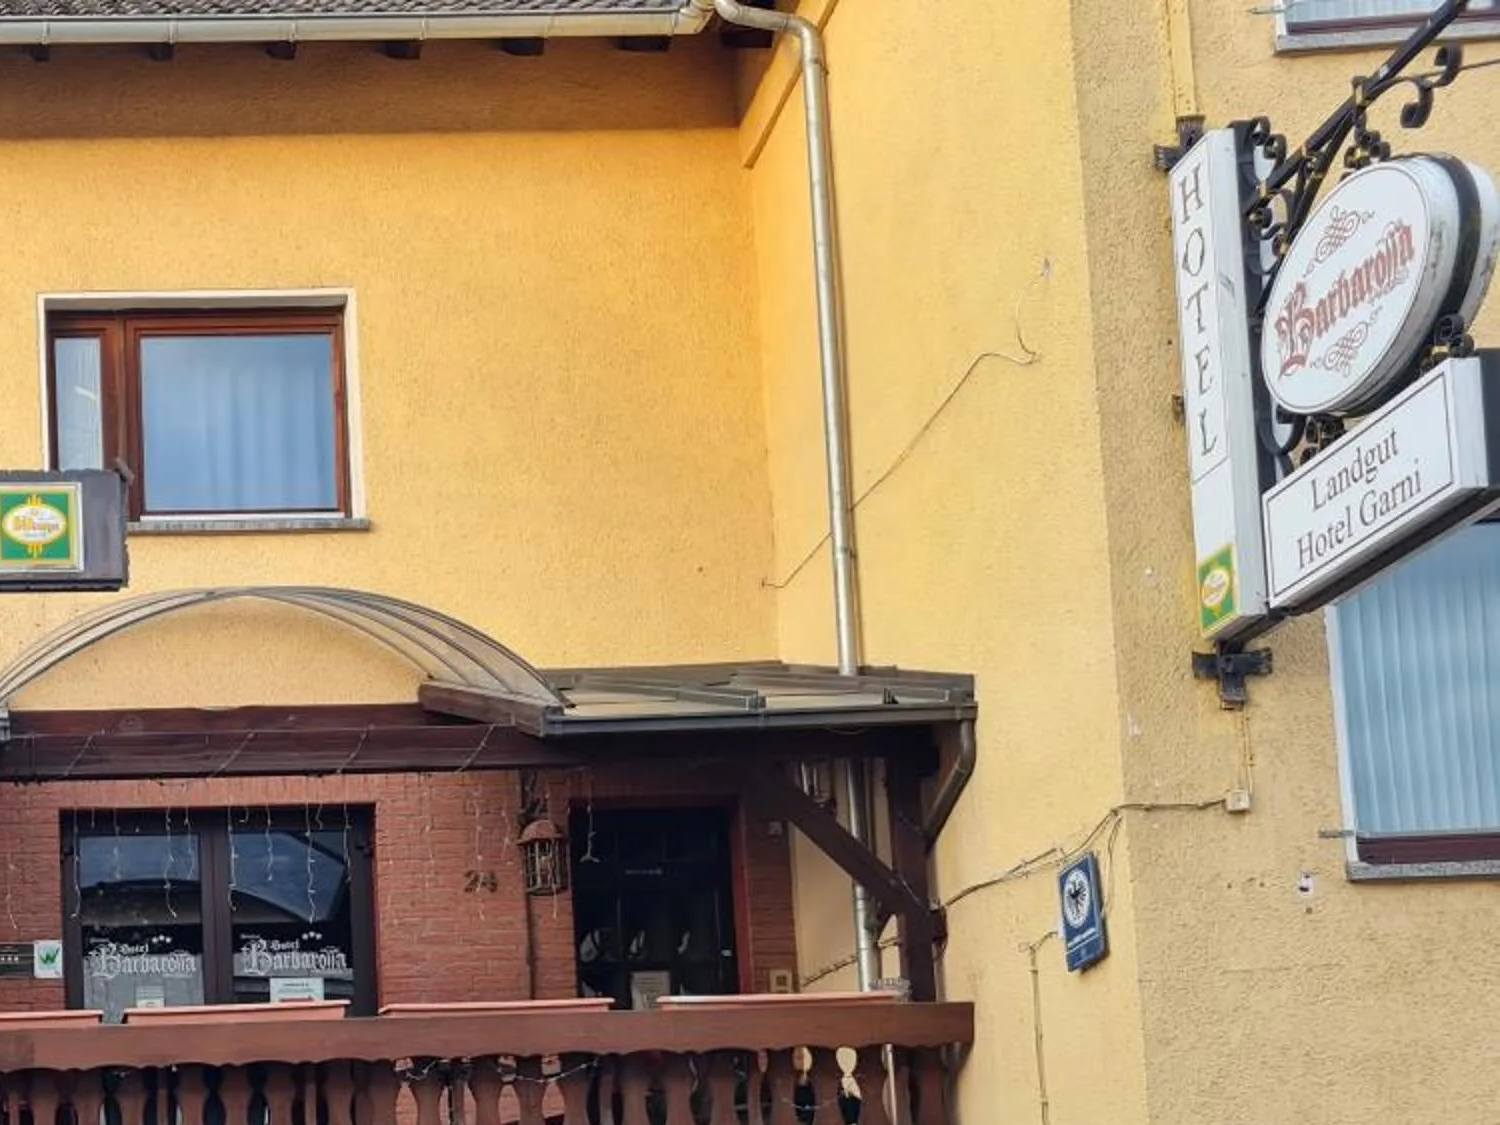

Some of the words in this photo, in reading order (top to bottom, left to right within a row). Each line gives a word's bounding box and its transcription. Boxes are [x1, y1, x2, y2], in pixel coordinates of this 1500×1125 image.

[1176, 163, 1219, 458] HOTEL
[1296, 505, 1354, 570] Hotel
[1358, 457, 1422, 527] Garni
[1310, 427, 1400, 512] Landgut
